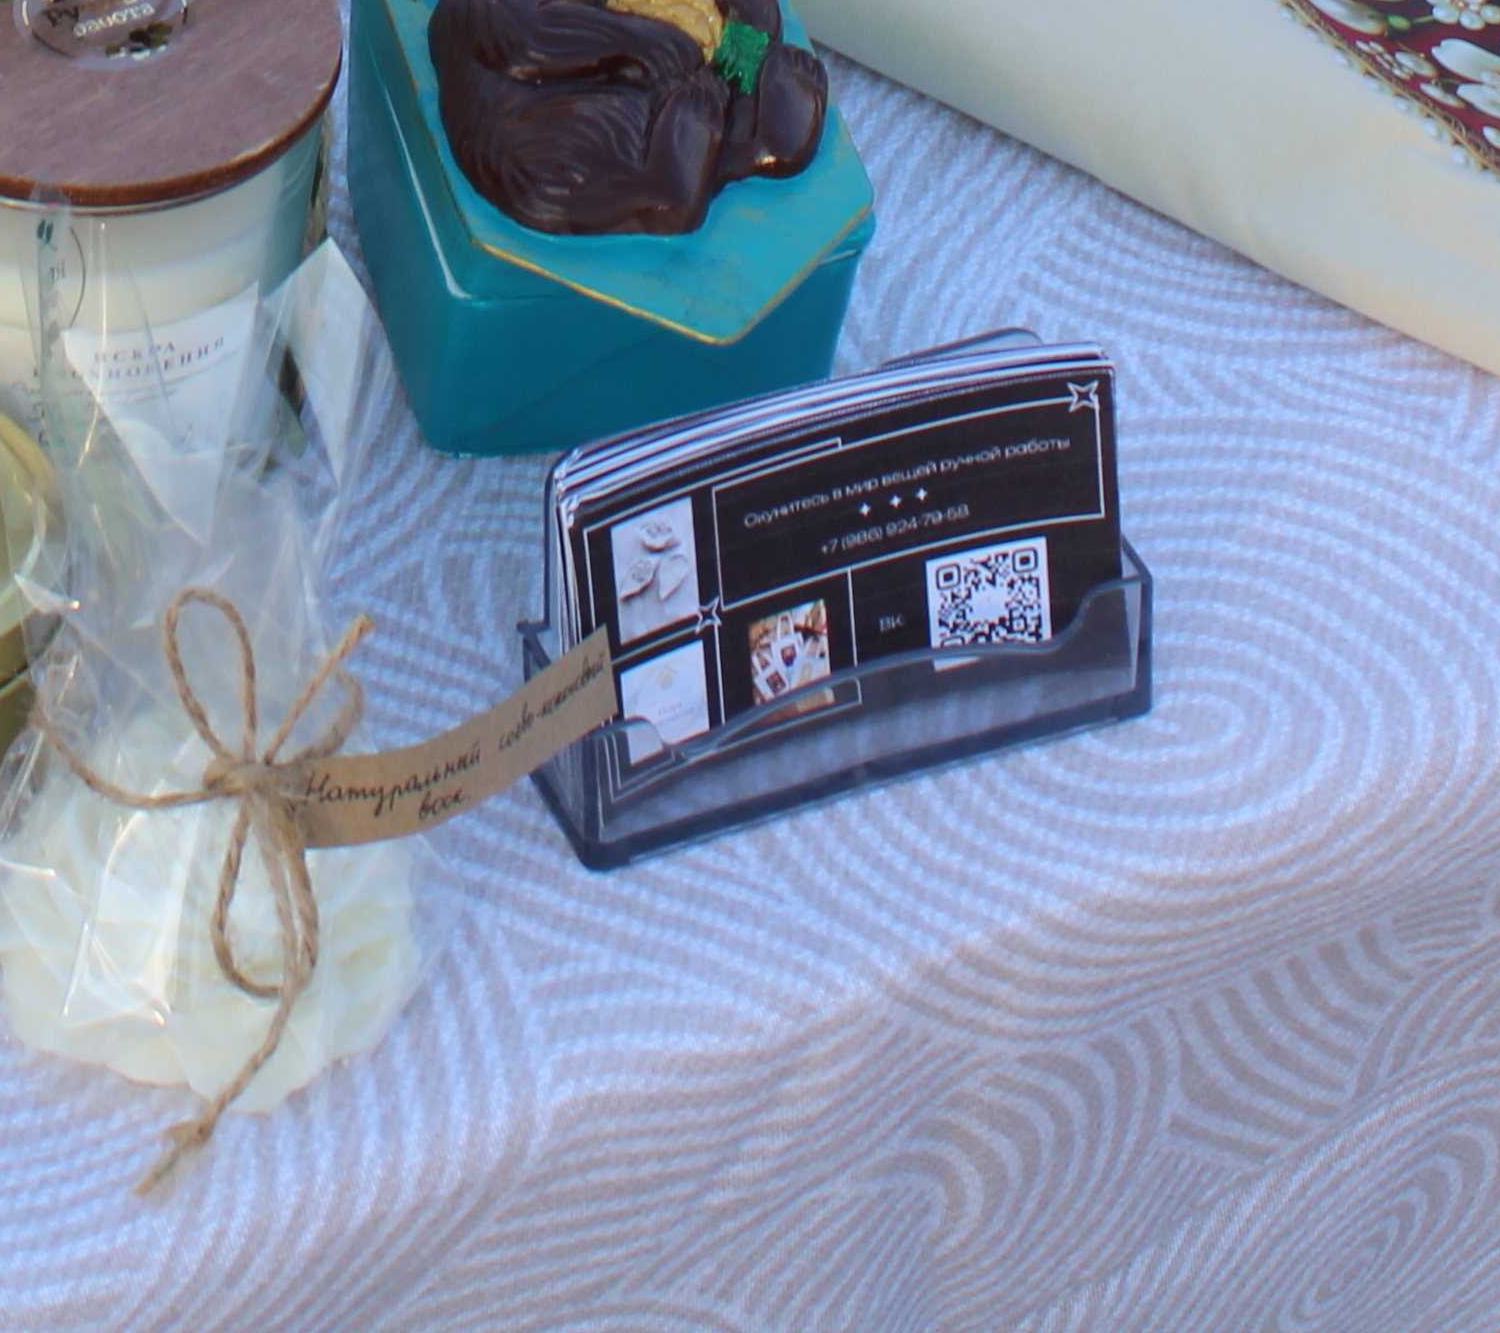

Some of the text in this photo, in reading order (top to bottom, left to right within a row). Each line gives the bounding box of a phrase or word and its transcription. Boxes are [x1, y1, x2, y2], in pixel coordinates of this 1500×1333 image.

[743, 492, 831, 529] Окунитесь
[845, 477, 880, 501] мир
[881, 460, 938, 487] вещей
[940, 445, 1002, 476] ручной
[1004, 436, 1072, 461] работы
[304, 738, 482, 819] Натуральный
